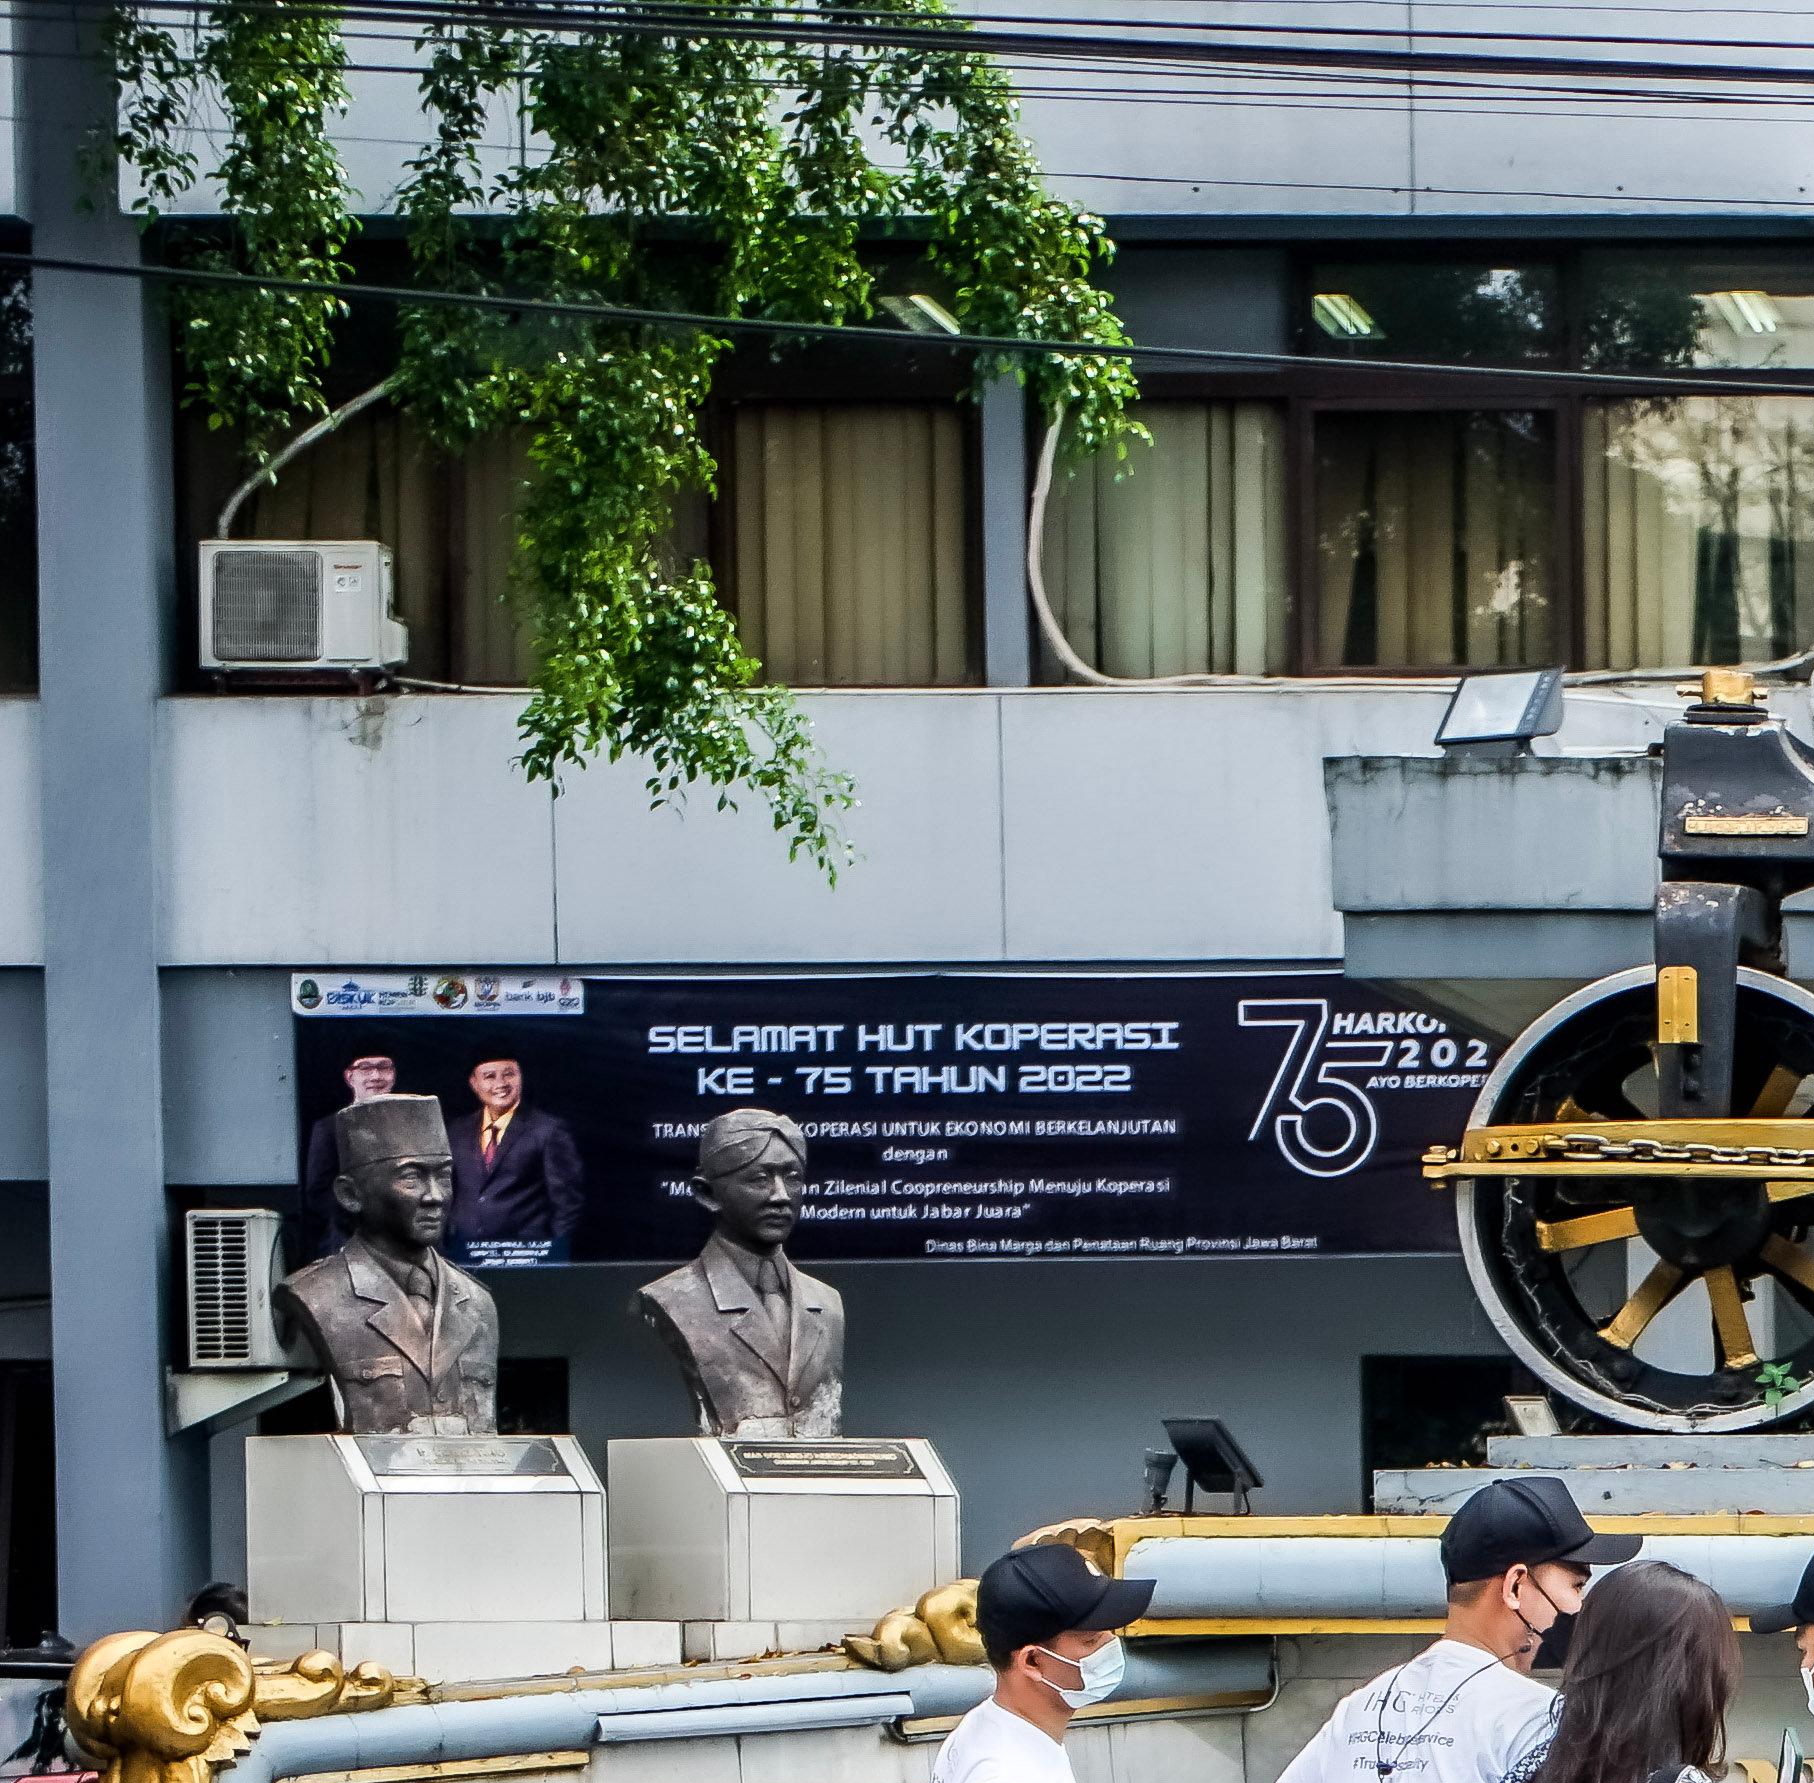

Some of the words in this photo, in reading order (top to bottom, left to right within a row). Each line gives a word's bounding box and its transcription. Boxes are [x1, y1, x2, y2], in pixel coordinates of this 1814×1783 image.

[1332, 1012, 1446, 1035] HARKO
[648, 1024, 844, 1053] SELAMAT
[857, 1023, 942, 1051] HUT
[955, 1022, 1180, 1051] KOPERASI
[697, 1067, 754, 1095] KE
[795, 1066, 852, 1095] 75
[865, 1065, 1006, 1095] TAHUN
[1018, 1064, 1133, 1093] 2022
[1365, 1075, 1400, 1089] AYO
[881, 1121, 941, 1138] UNTUK
[944, 1120, 1031, 1137] EKONOMI
[1034, 1118, 1177, 1137] BERKELANJUTAN
[881, 1146, 949, 1165] dengan
[823, 1179, 887, 1196] Zilenial
[890, 1177, 1025, 1198] Coopreneurship
[1028, 1177, 1093, 1198] Menuju
[1095, 1176, 1171, 1196] Koperasi
[801, 1204, 866, 1220] Modern
[869, 1203, 918, 1219] untuk
[920, 1202, 972, 1220] Jabar
